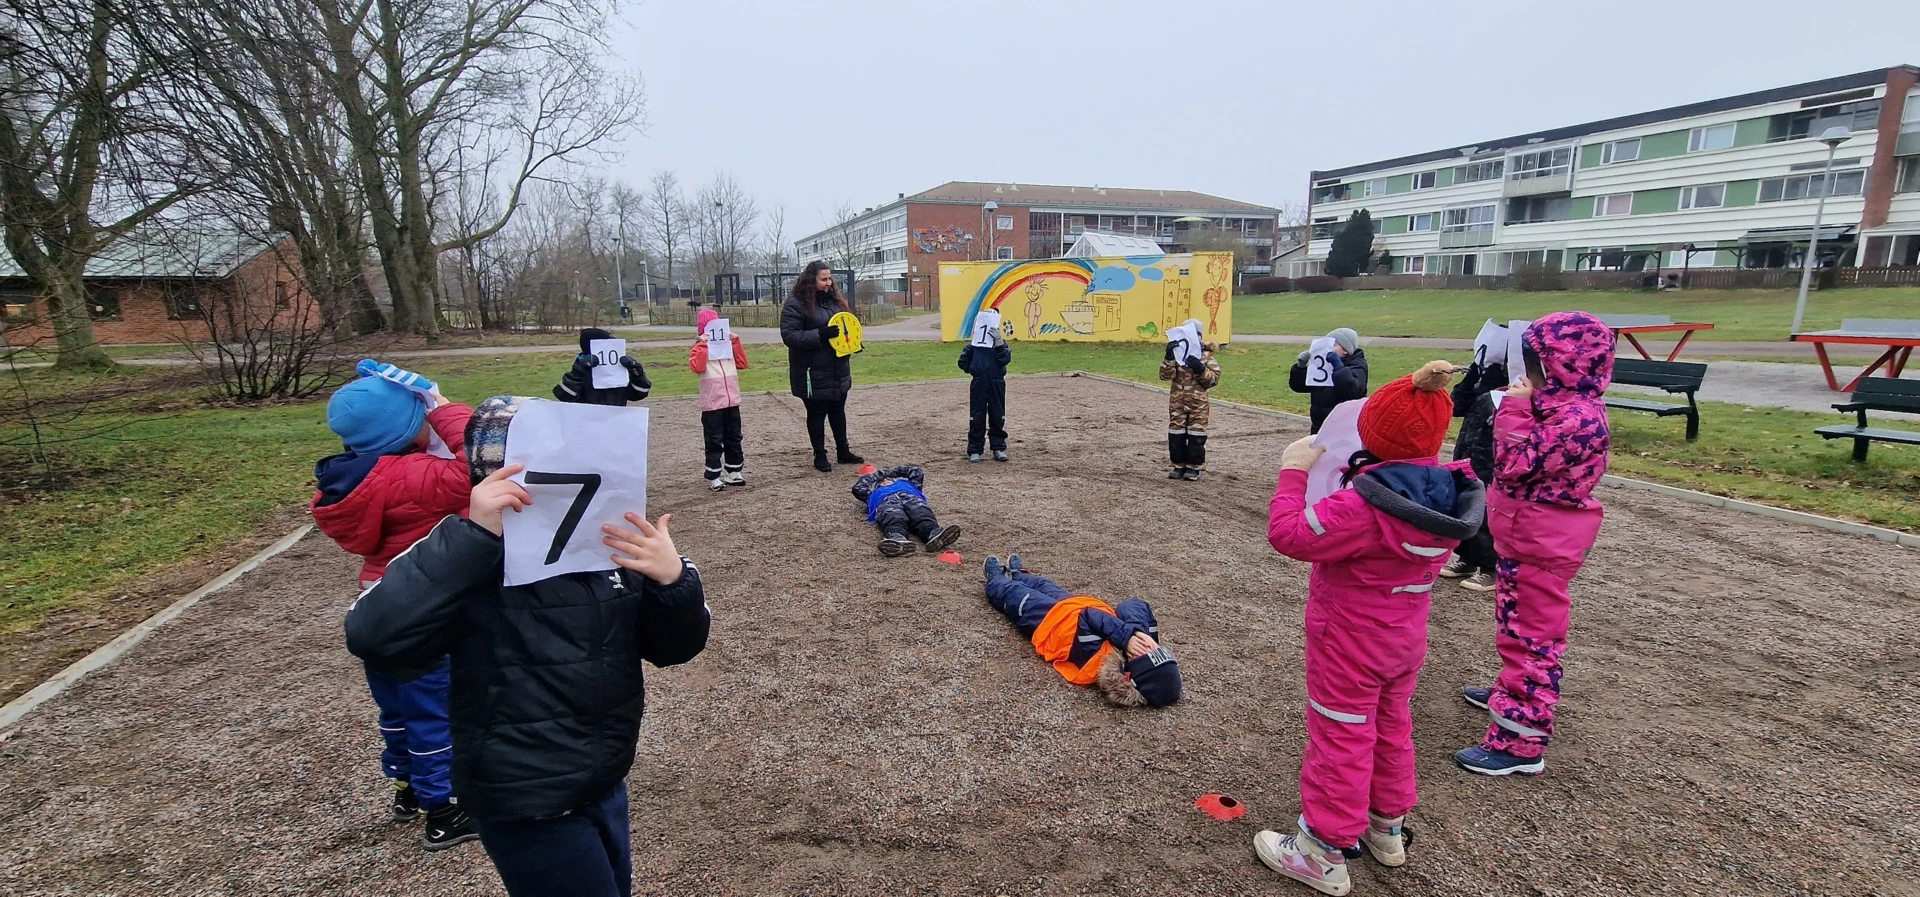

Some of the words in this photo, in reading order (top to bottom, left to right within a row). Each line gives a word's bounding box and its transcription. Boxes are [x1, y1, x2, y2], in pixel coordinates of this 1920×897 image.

[709, 328, 726, 342] 11
[977, 324, 988, 345] 1
[598, 349, 619, 366] 10
[1312, 355, 1329, 383] 3
[523, 470, 602, 566] 7
